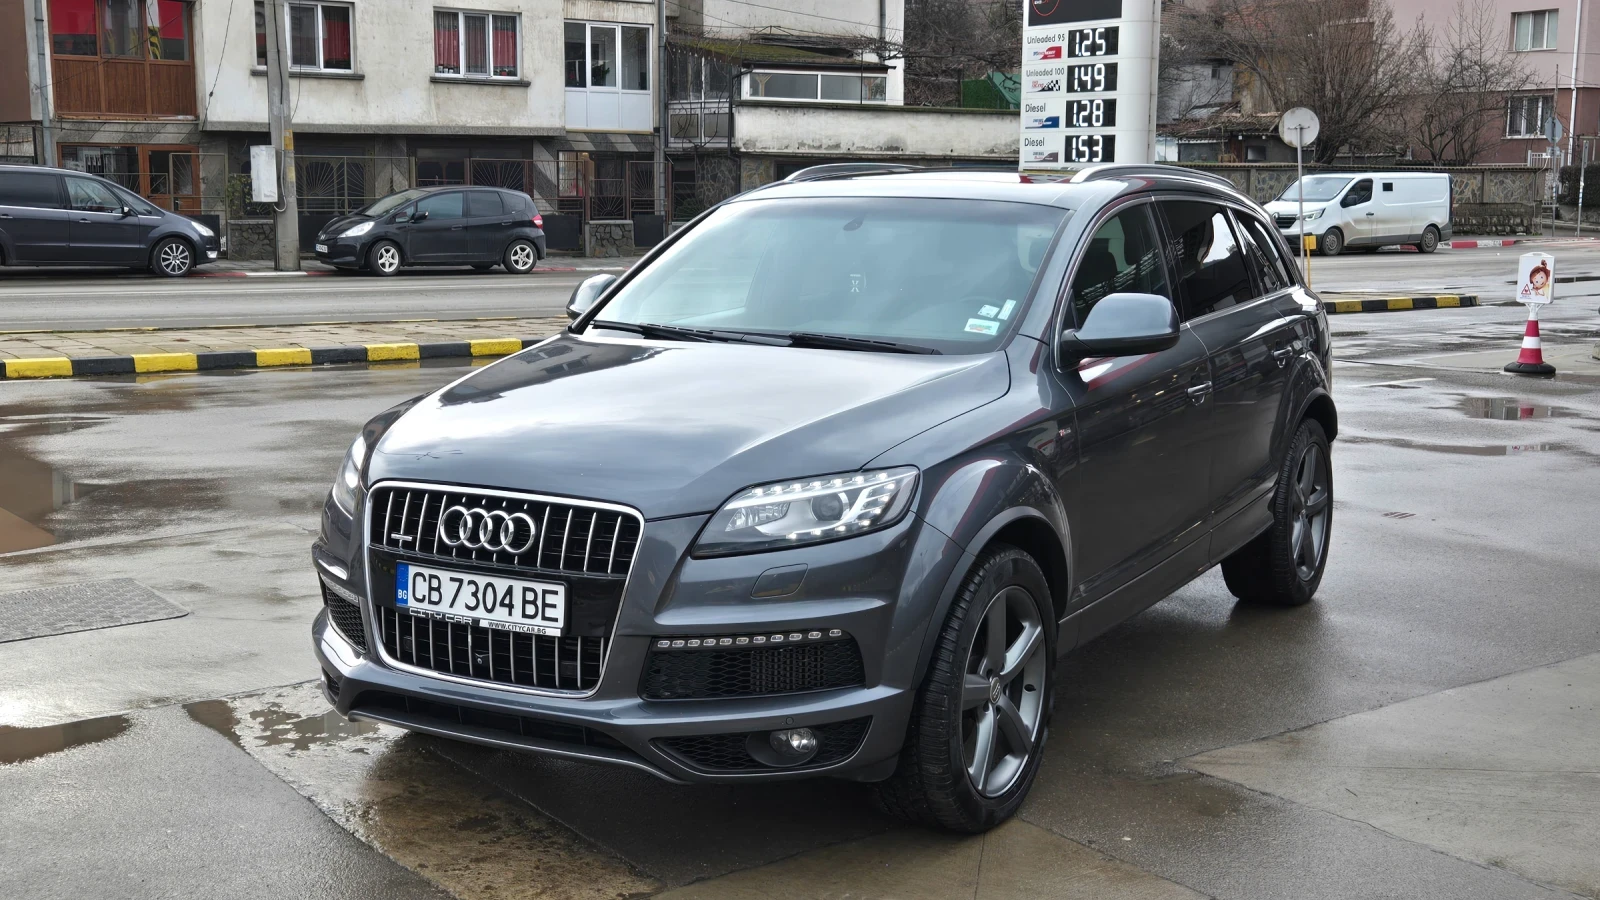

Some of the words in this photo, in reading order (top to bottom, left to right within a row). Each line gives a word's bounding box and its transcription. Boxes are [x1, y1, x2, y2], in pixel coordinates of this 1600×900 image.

[1027, 34, 1056, 44] Unleaded
[1057, 33, 1066, 42] 95
[1026, 68, 1054, 77] Unleaded
[1054, 67, 1065, 76] 100
[1025, 102, 1046, 113] Diesel
[1024, 137, 1045, 147] Diesel
[397, 588, 408, 600] BG
[449, 576, 515, 617] 7304
[409, 607, 443, 619] CITY
[445, 614, 473, 626] CAR
[488, 620, 547, 635] WWW.CITYCAR.BG
